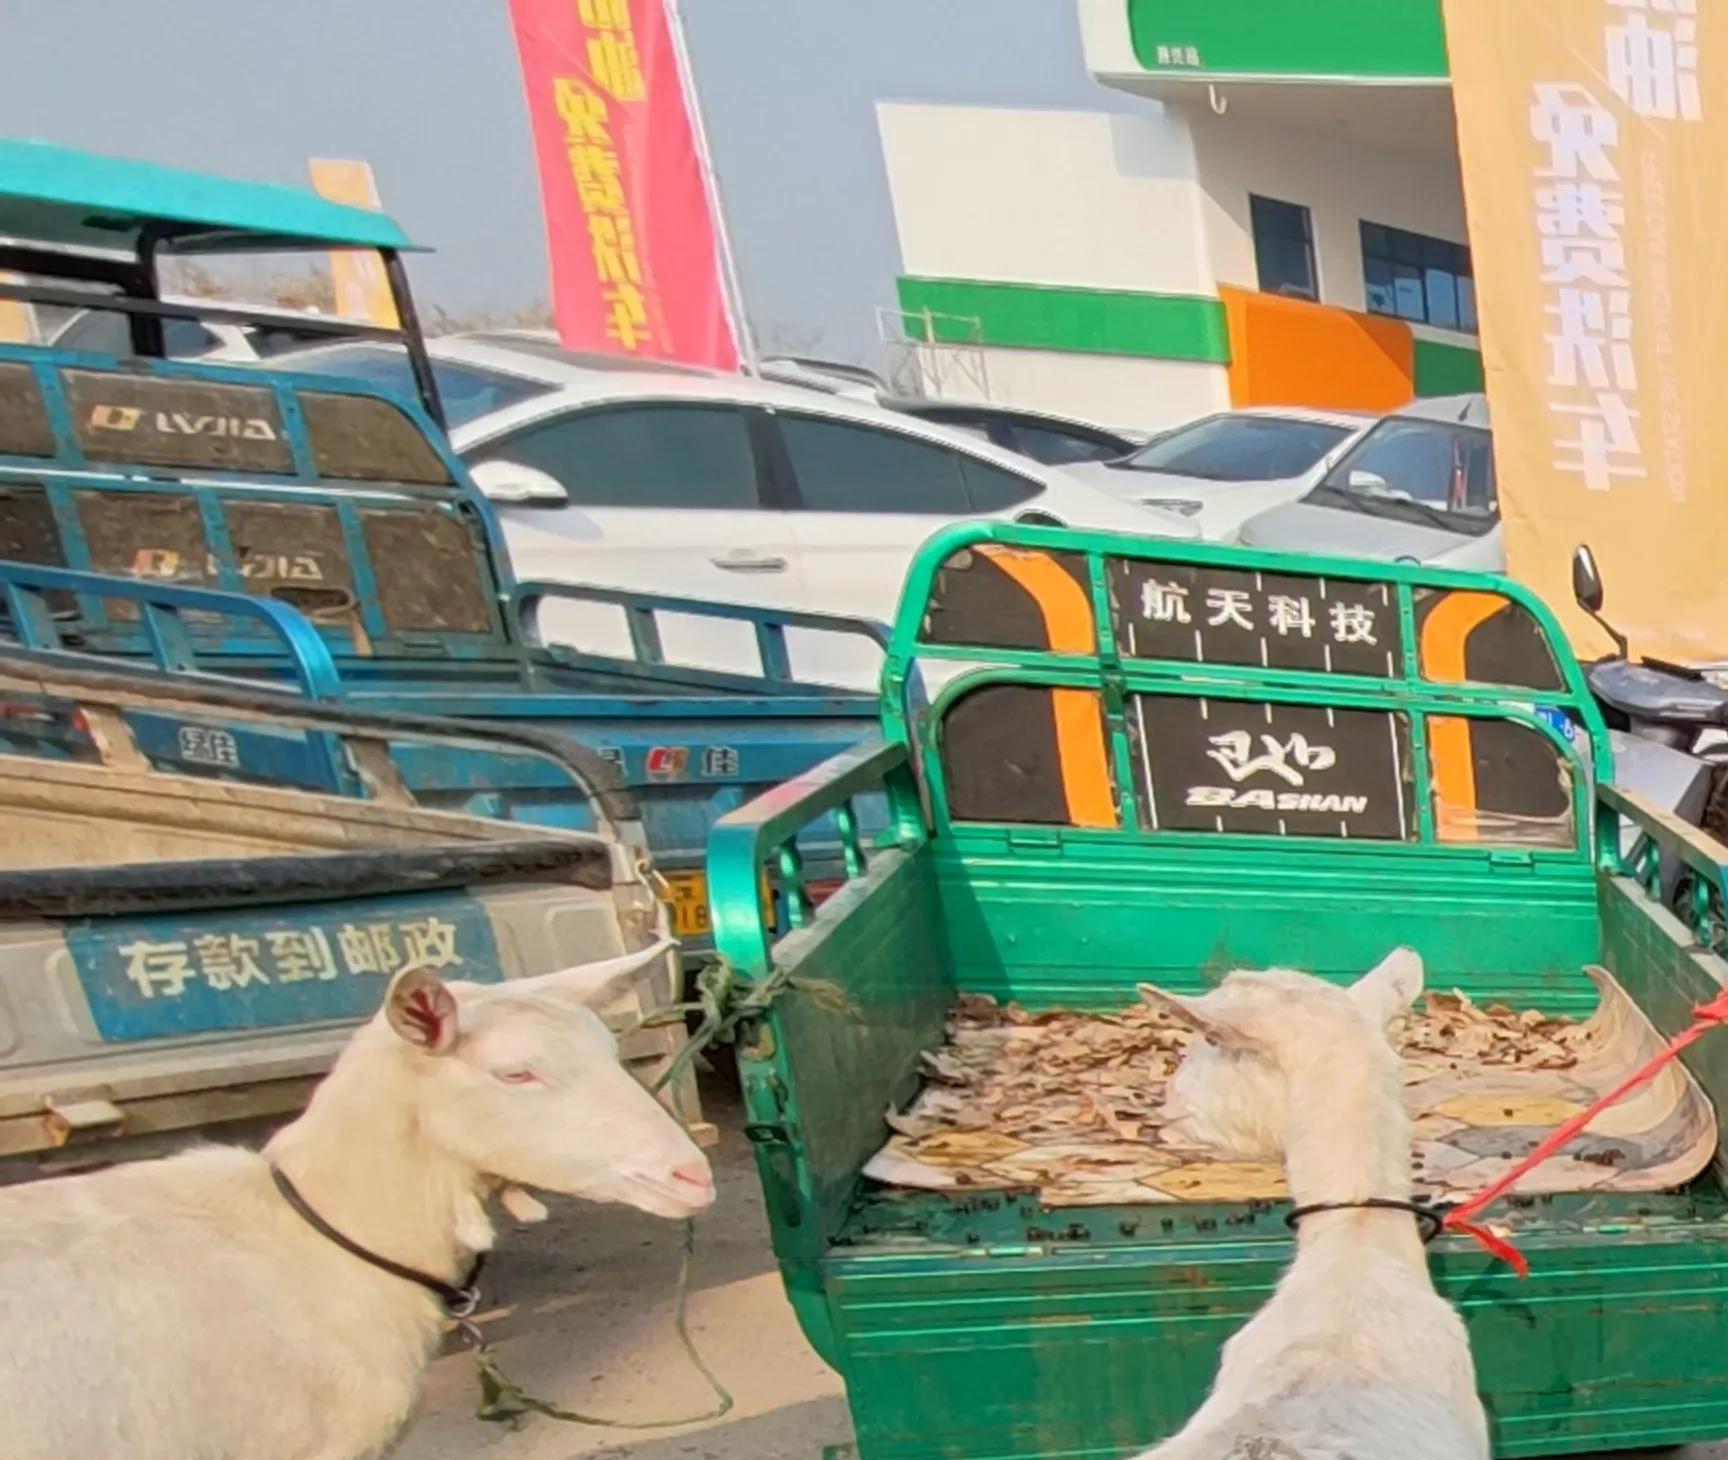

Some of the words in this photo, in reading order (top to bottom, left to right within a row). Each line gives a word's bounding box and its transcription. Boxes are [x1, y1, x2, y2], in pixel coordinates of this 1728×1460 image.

[1140, 578, 1378, 646] 航天科技
[1186, 786, 1368, 814] BASHAN
[118, 916, 465, 998] 存款到邮政
